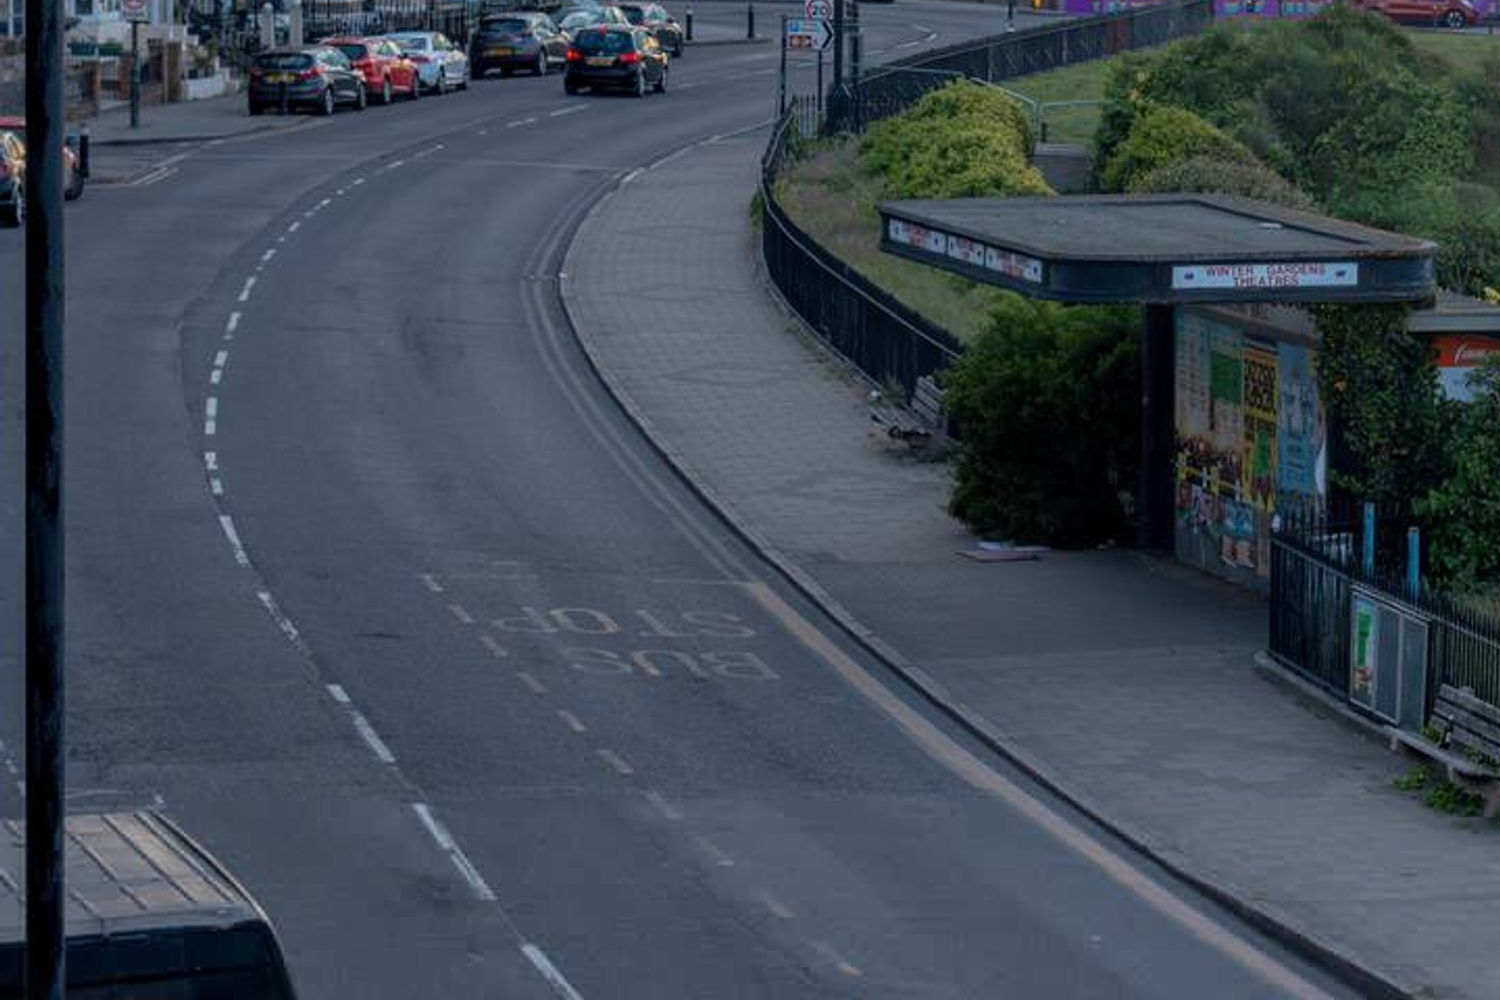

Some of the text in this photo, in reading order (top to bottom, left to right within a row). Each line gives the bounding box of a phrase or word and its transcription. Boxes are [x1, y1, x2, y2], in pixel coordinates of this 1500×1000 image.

[1206, 264, 1327, 277] WINTER GARDENS
[1233, 275, 1300, 287] THEATRES
[492, 606, 757, 637] STOP
[570, 647, 781, 681] BUS
